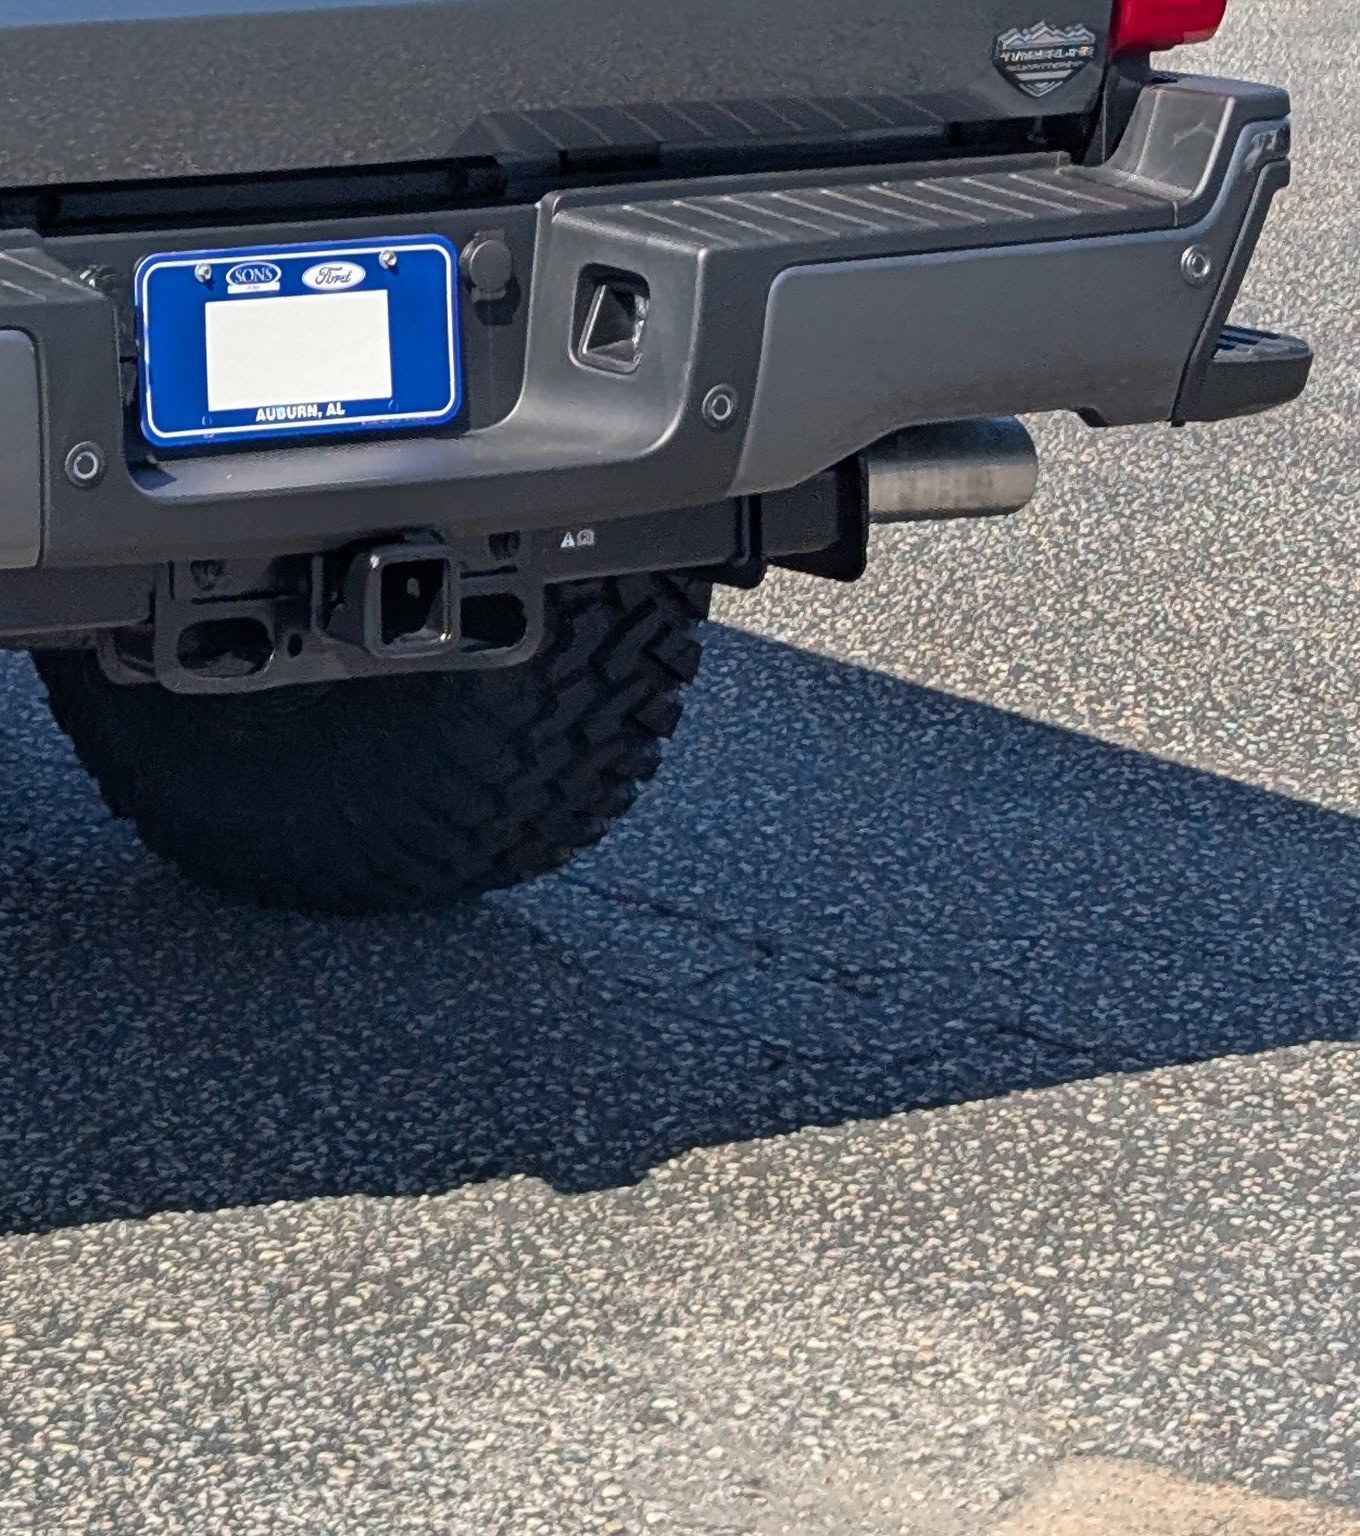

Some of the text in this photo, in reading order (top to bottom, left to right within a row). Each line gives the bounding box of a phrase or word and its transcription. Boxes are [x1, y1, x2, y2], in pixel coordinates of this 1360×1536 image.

[235, 266, 273, 283] SONS
[314, 265, 353, 287] Ford
[255, 402, 346, 422] AUBURN, AL
